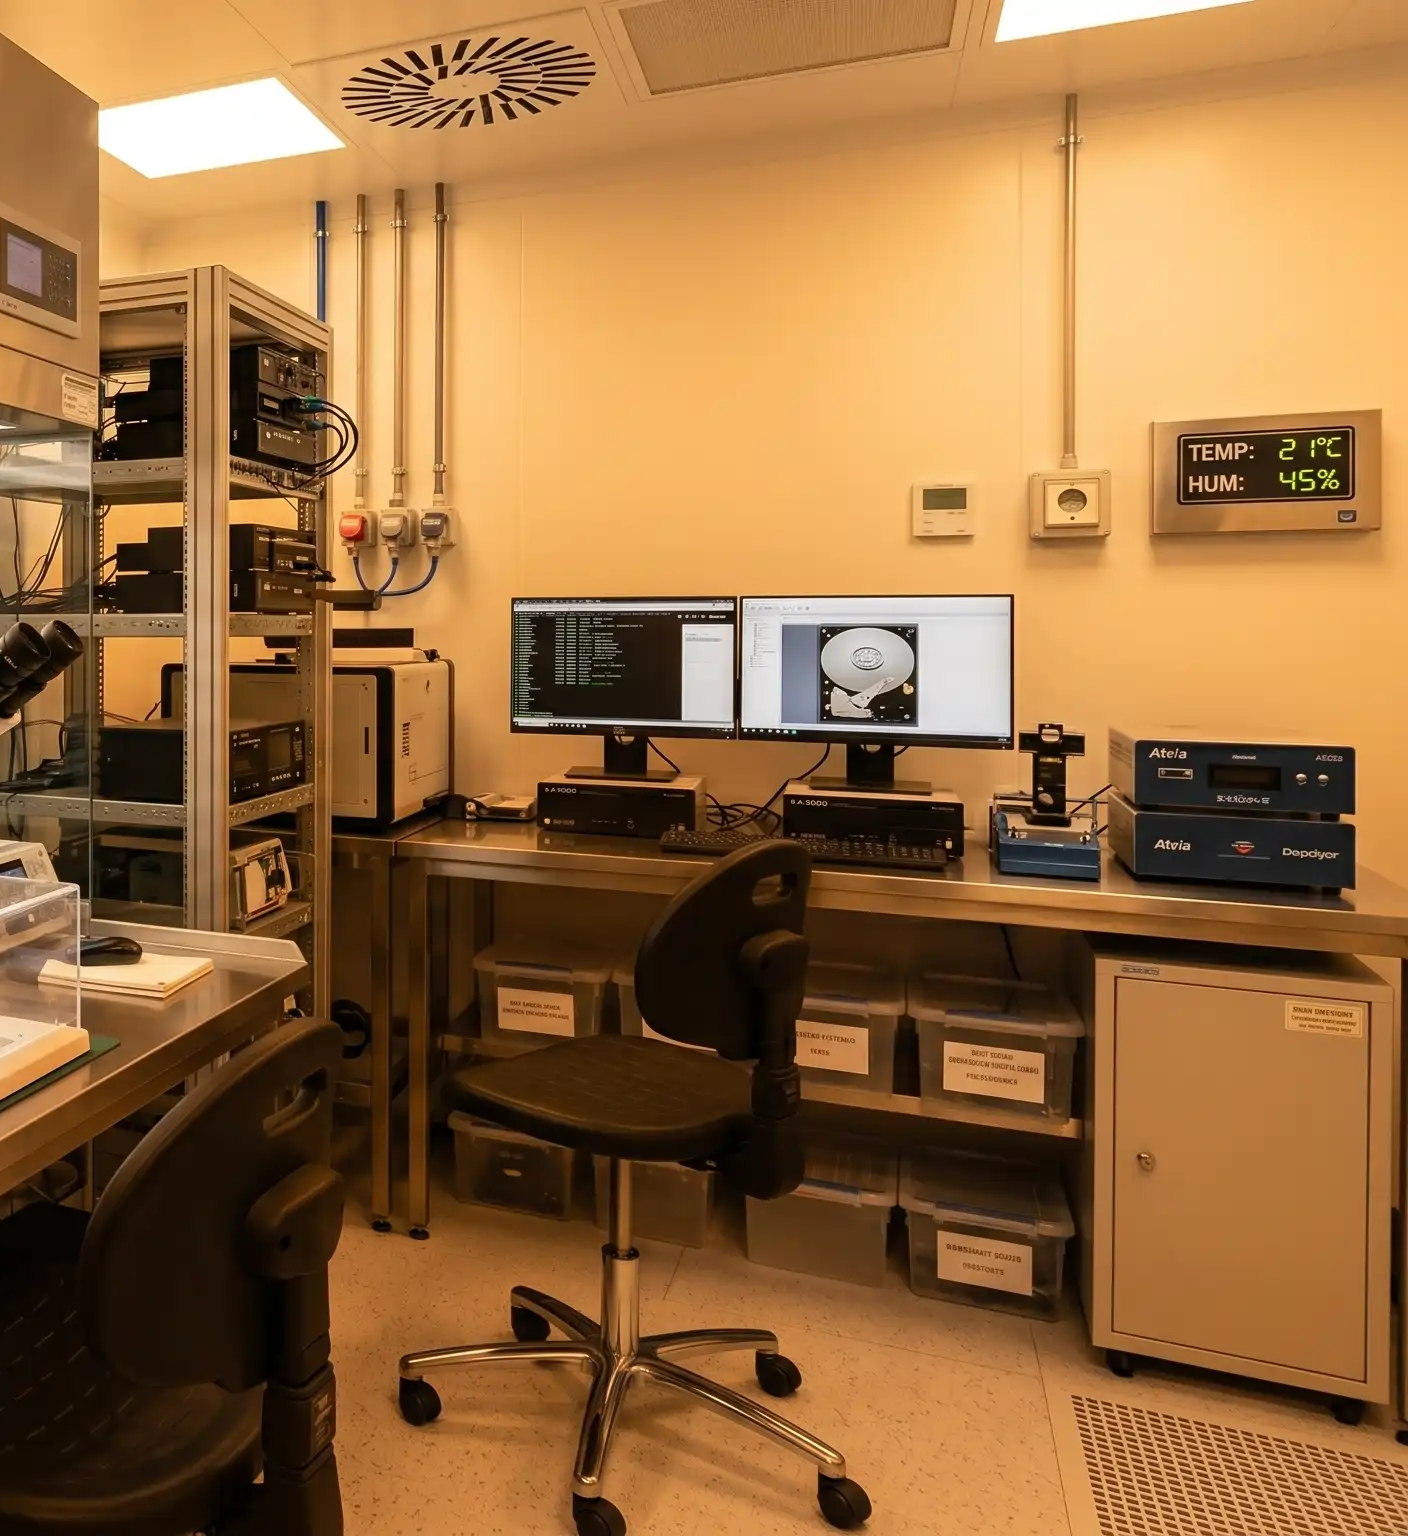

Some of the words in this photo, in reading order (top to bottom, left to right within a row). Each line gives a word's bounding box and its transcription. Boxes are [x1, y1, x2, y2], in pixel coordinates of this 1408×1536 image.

[1188, 442, 1255, 463] TEMP:
[1188, 473, 1245, 494] HUM:
[1279, 469, 1340, 491] 45%
